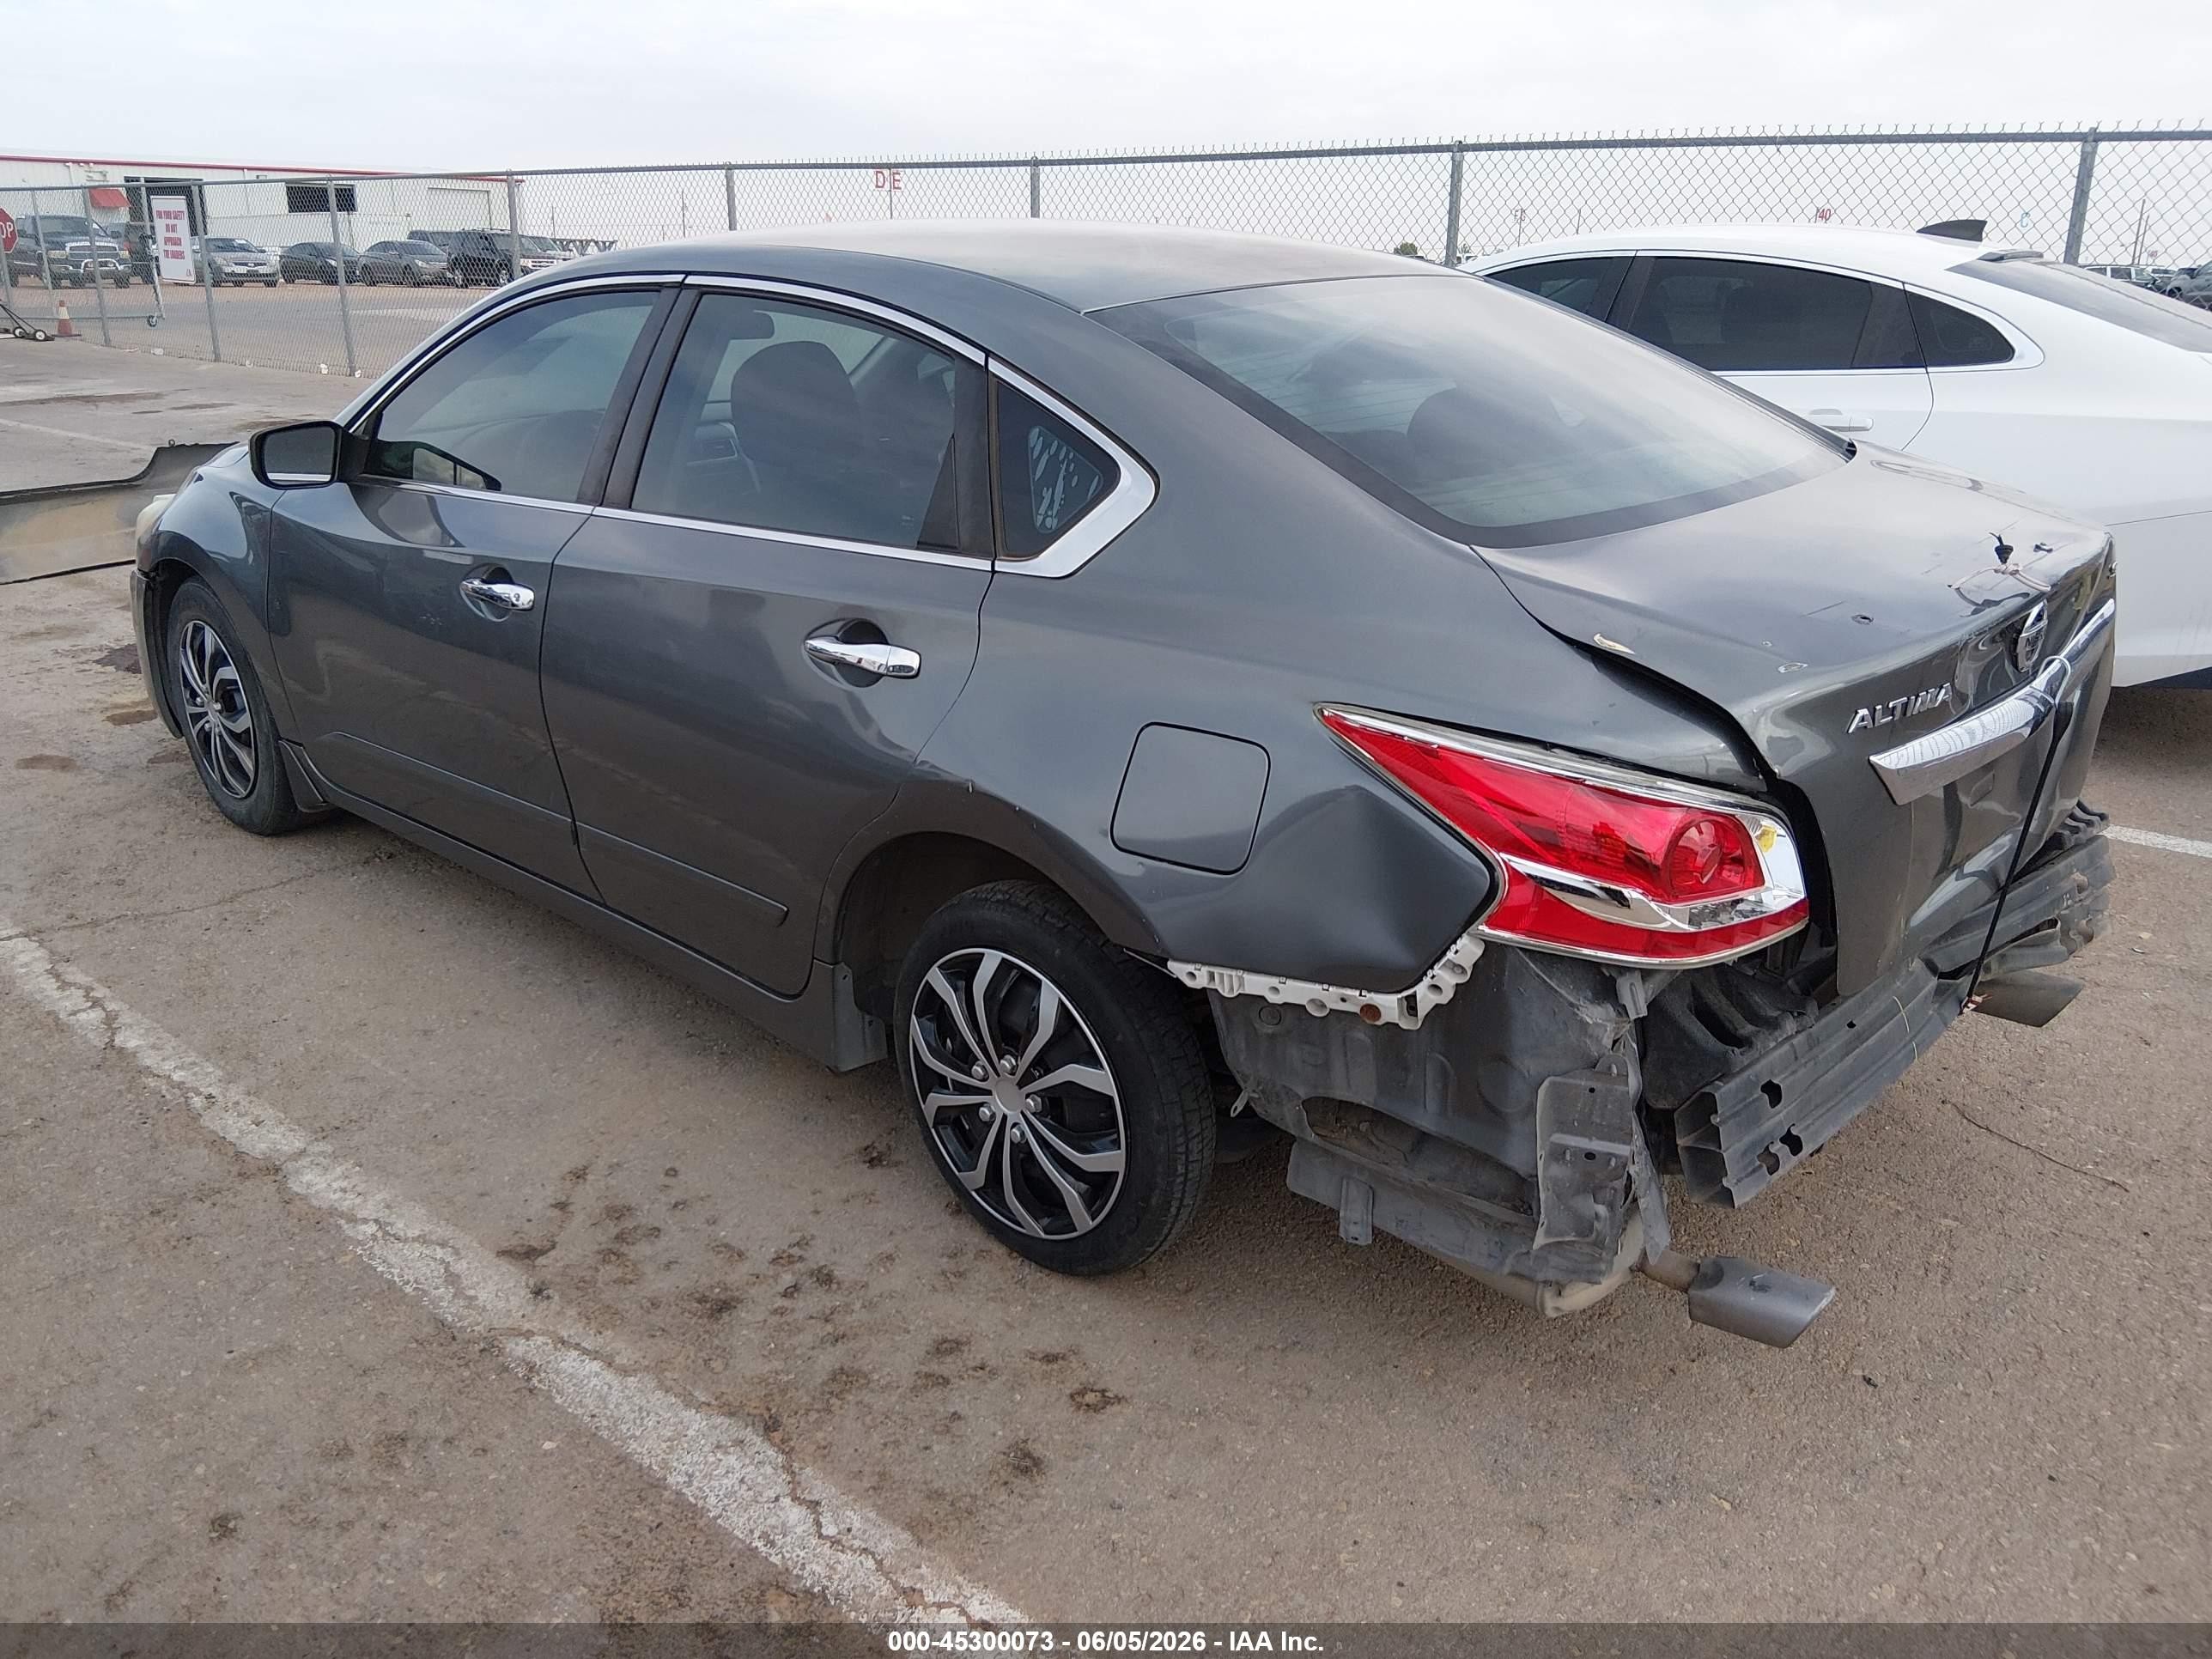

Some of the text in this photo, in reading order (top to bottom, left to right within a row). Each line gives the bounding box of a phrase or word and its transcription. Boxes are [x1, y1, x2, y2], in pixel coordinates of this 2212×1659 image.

[875, 171, 902, 190] D E
[1847, 682, 1954, 734] ALTIMA
